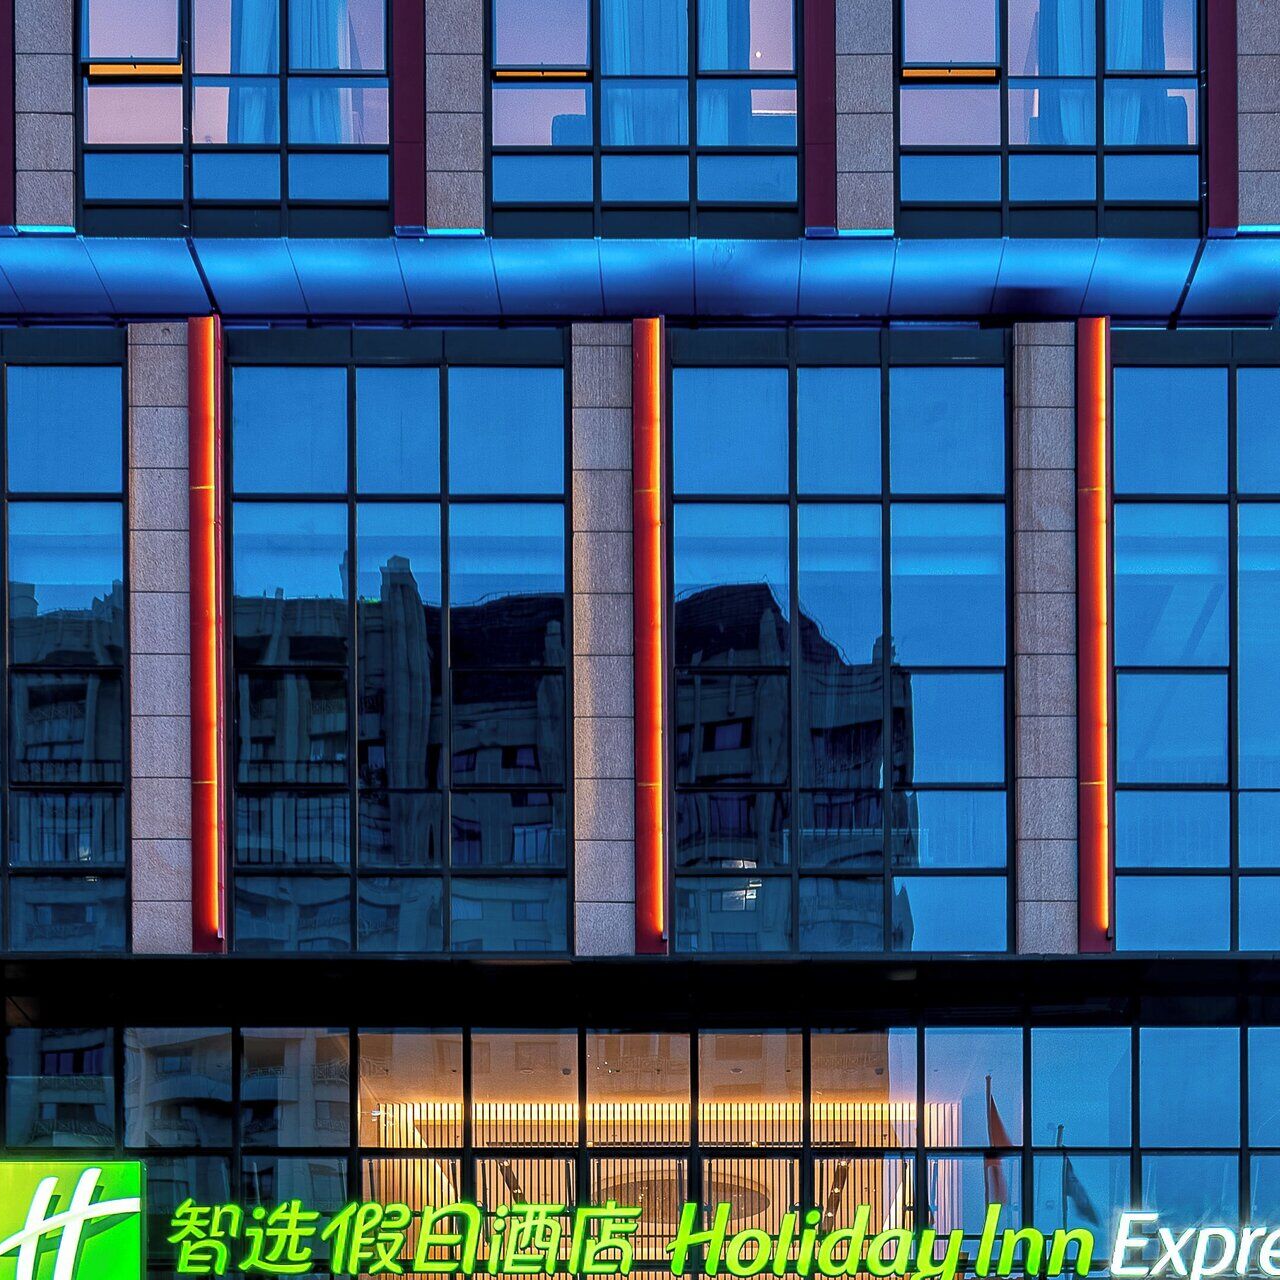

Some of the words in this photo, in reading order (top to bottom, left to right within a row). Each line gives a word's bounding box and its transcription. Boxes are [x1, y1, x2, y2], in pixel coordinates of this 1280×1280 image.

[166, 1200, 641, 1276] 智选假日酒店
[974, 1204, 1094, 1277] Inn
